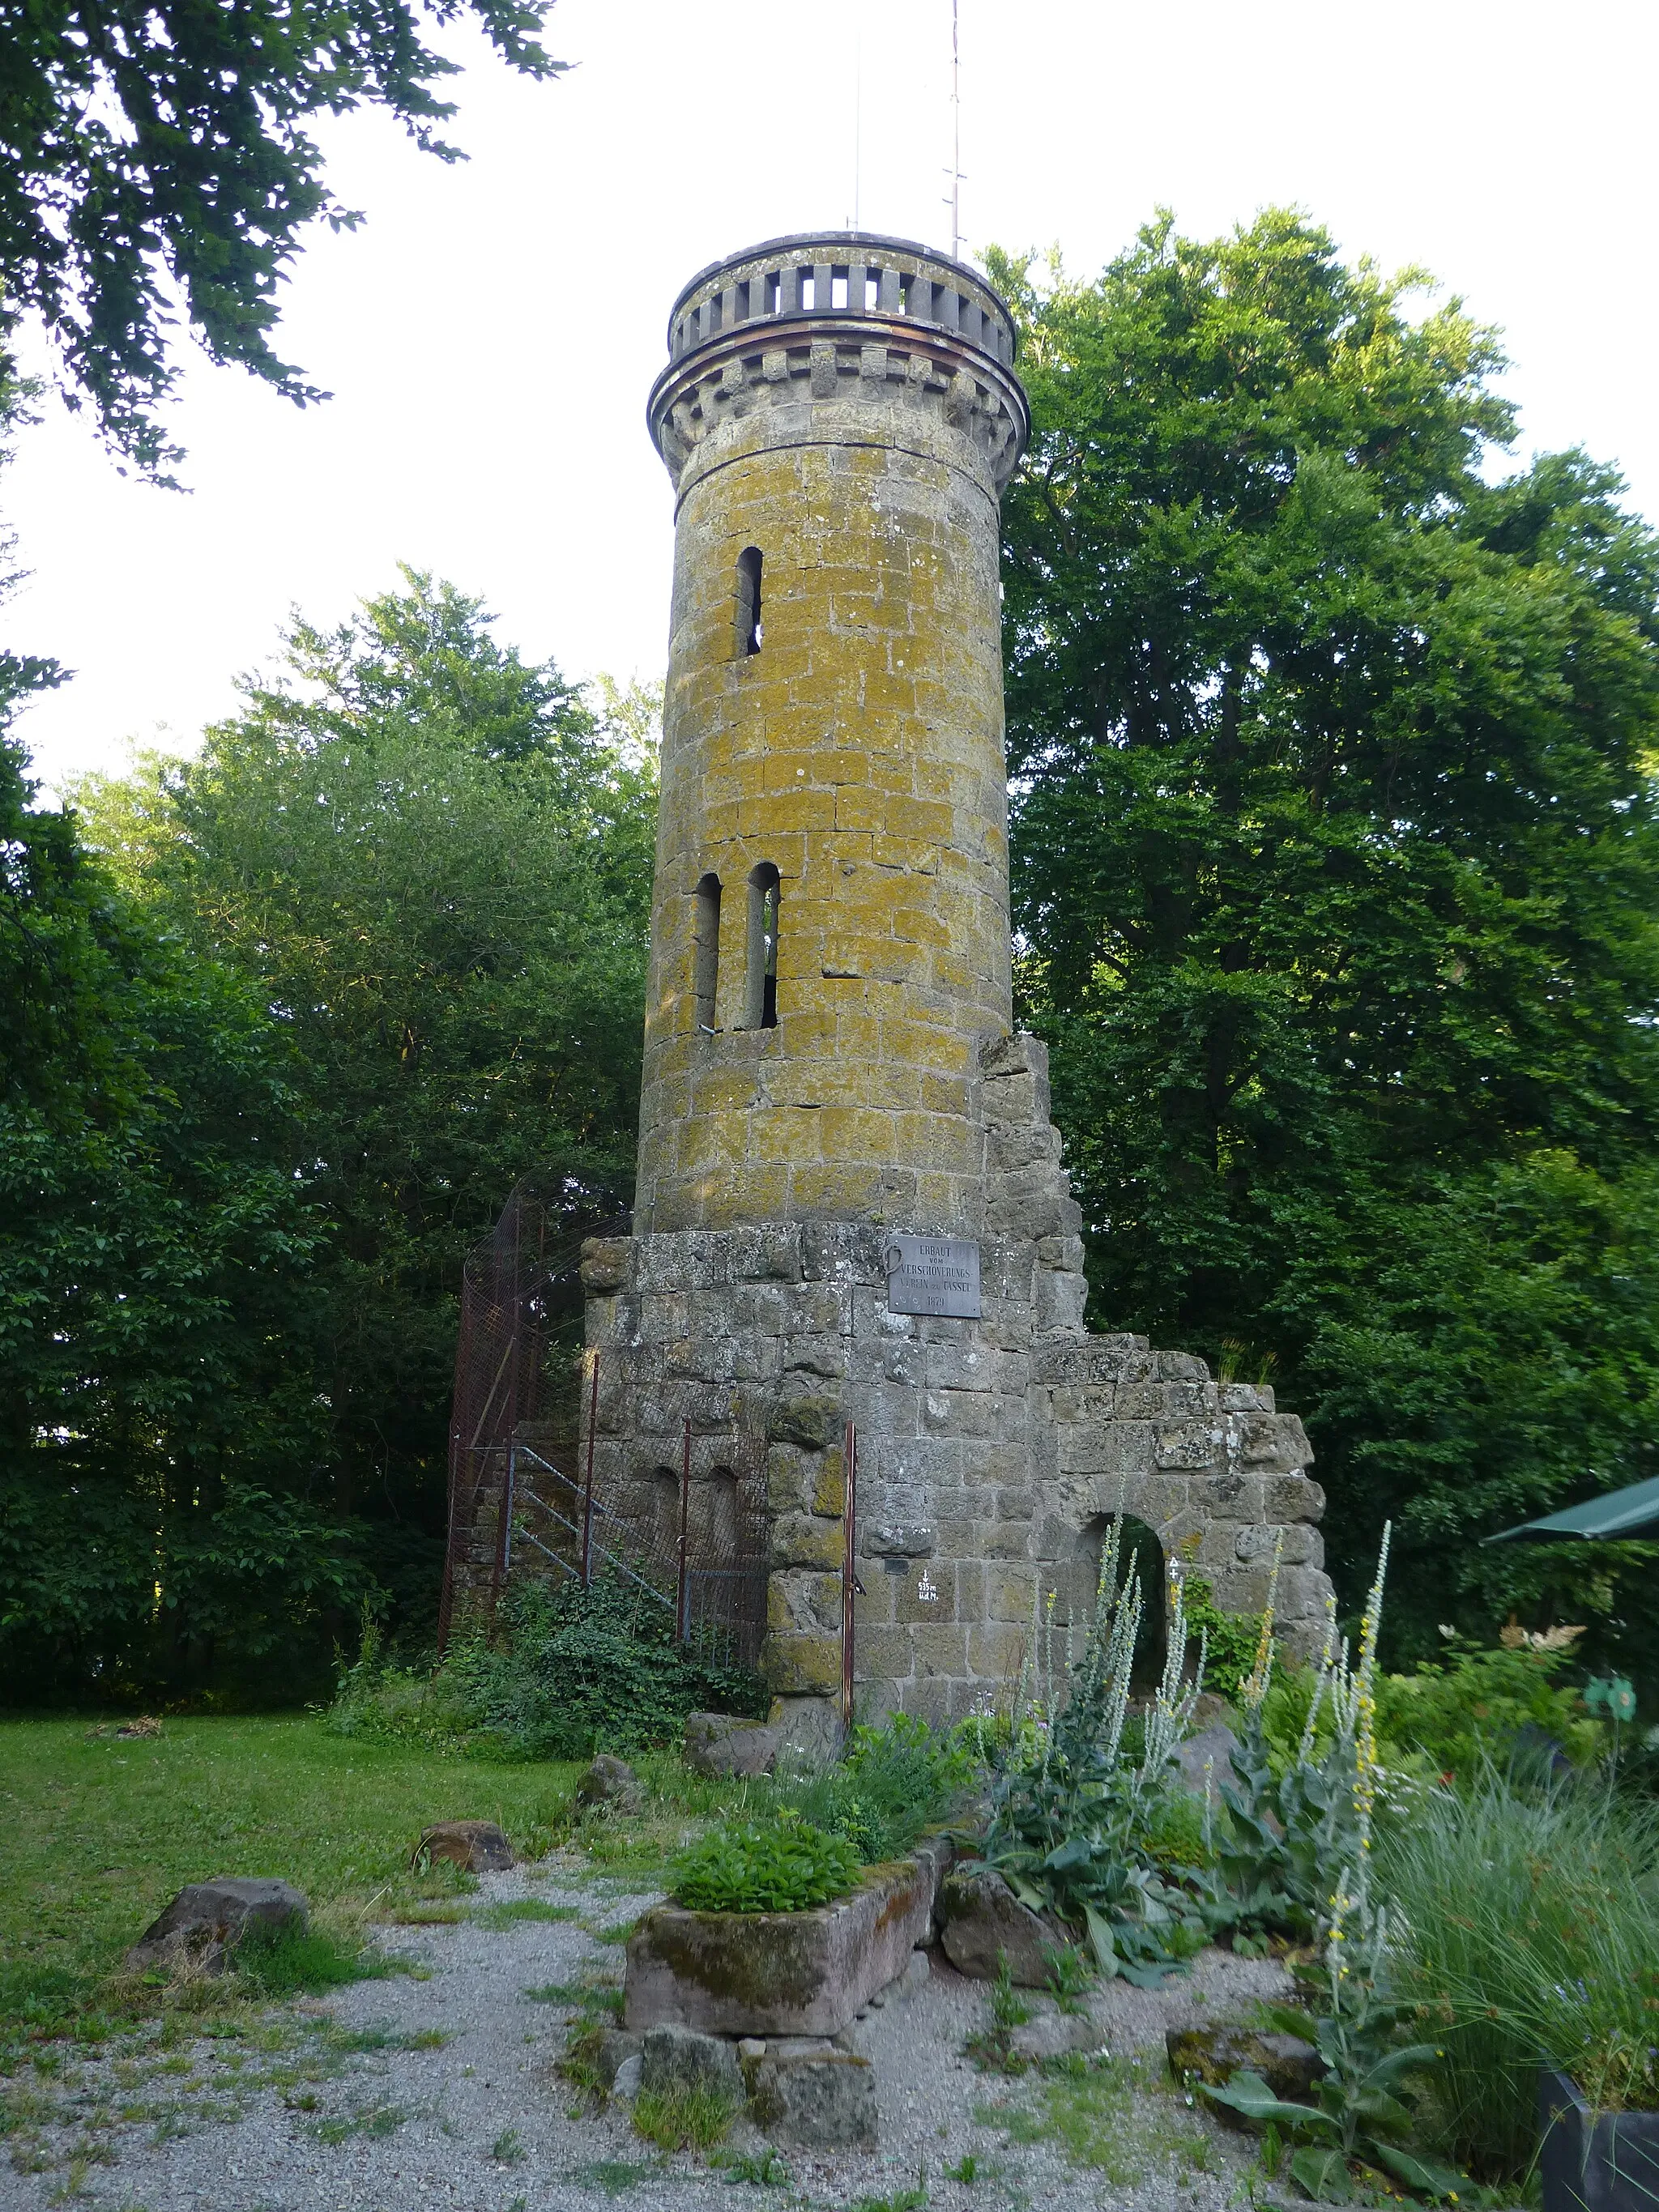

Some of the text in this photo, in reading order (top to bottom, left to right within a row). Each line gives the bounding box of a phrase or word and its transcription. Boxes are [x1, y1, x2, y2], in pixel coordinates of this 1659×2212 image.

[920, 1245, 951, 1257] ERBAUT
[944, 1281, 970, 1292] CASSEL
[928, 1296, 944, 1306] 1879
